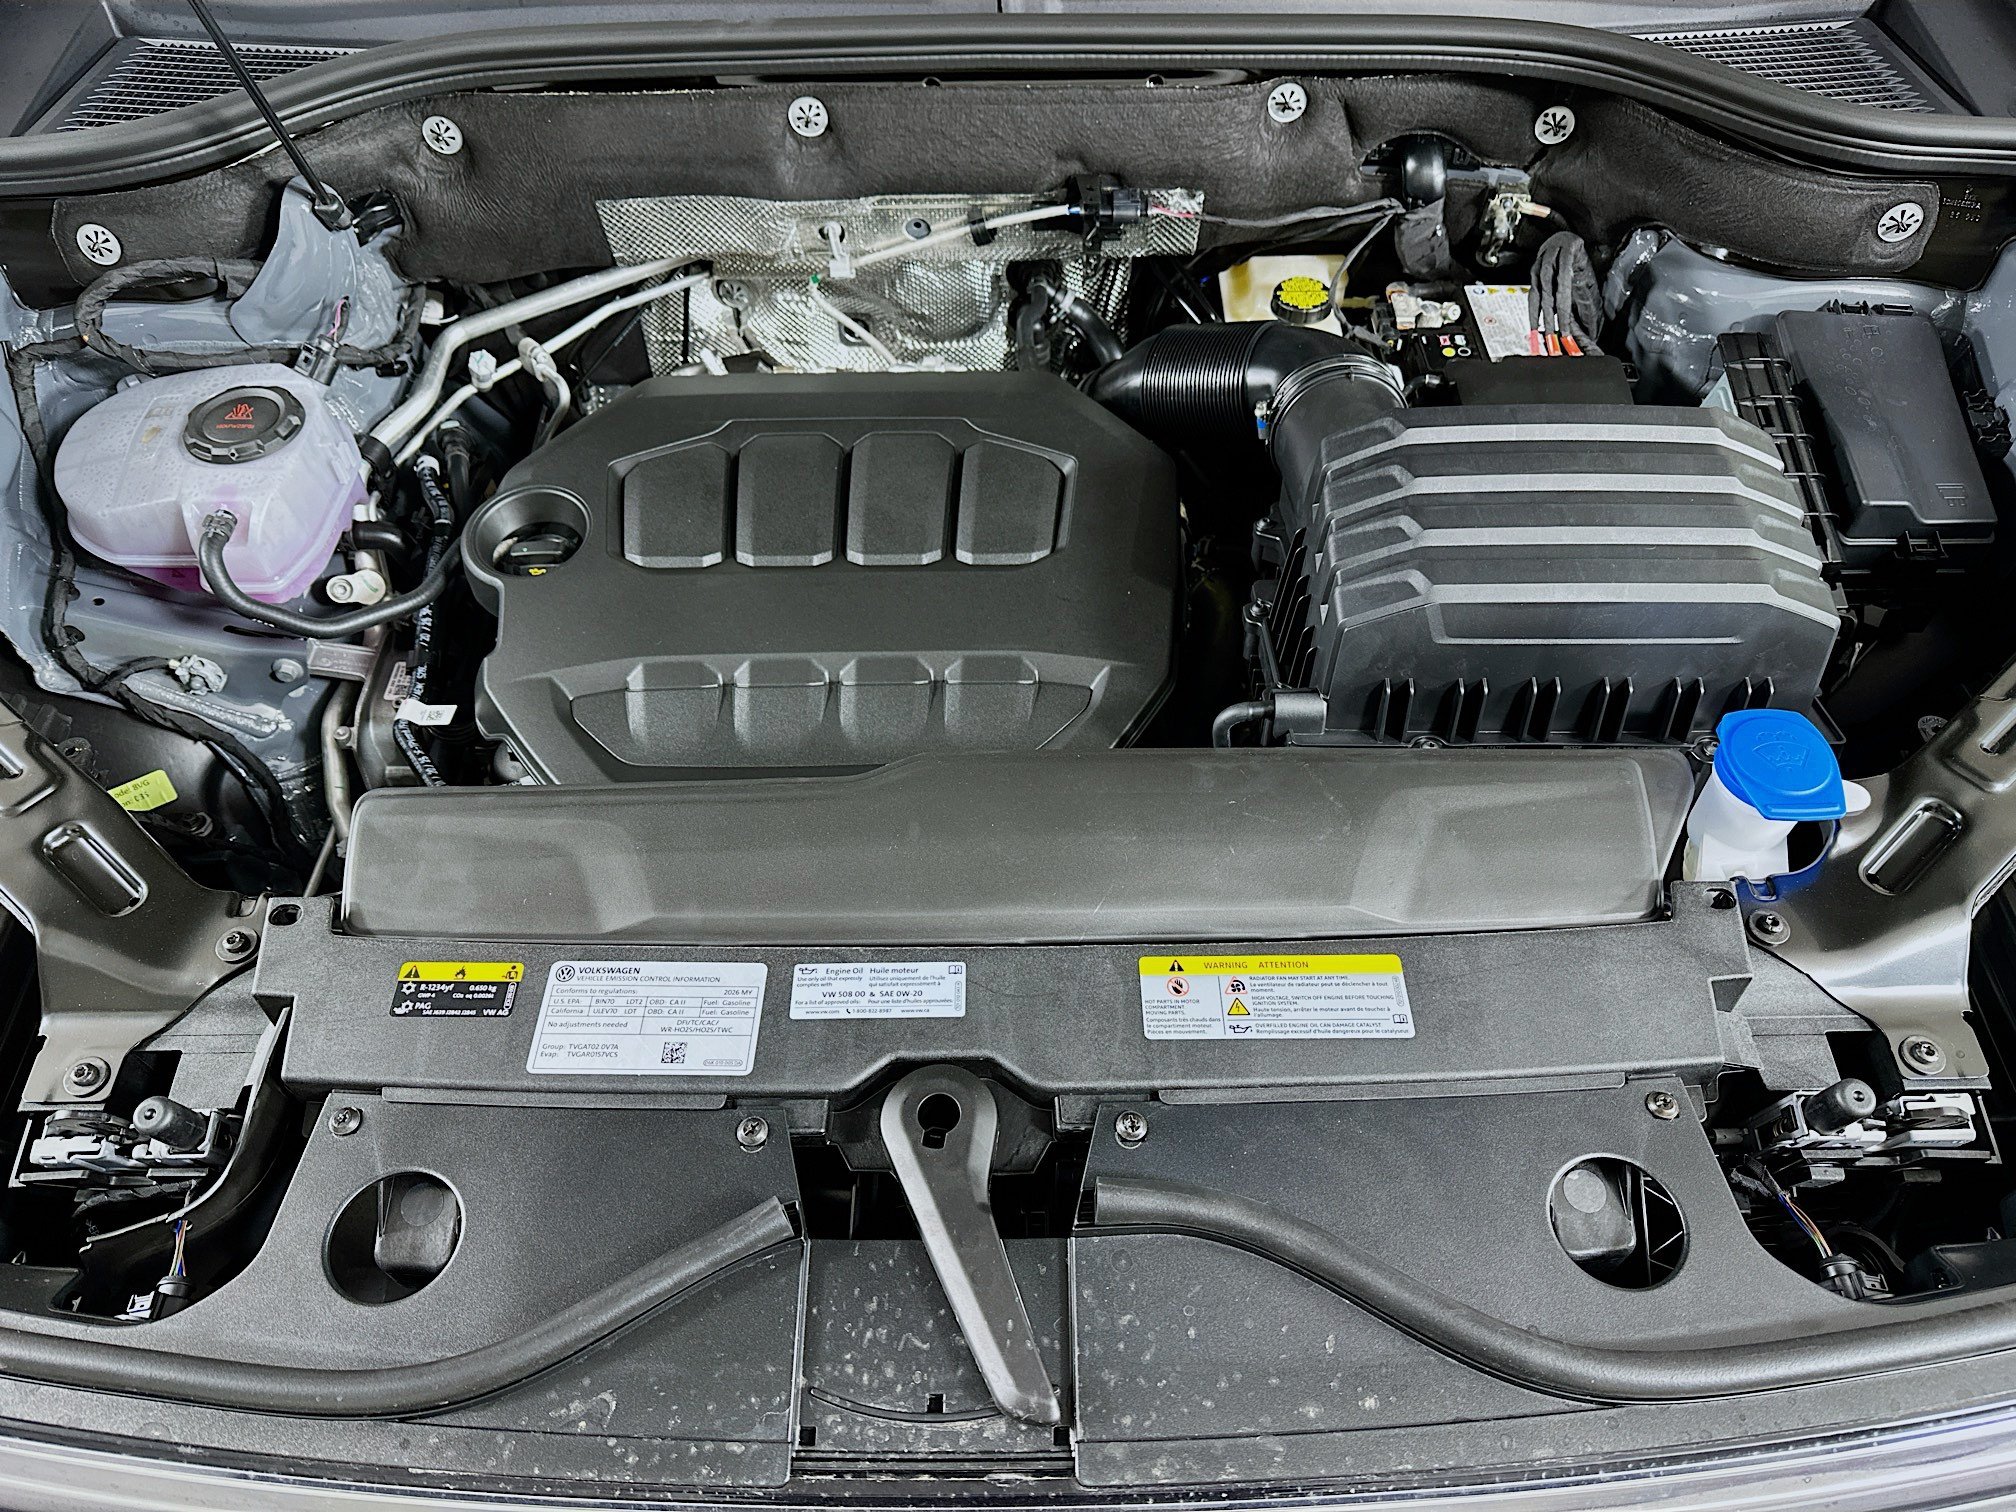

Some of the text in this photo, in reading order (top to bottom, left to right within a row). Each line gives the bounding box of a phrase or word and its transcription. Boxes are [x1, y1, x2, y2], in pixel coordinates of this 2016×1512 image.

[1204, 961, 1309, 969] WARNING ATTENTION
[826, 967, 851, 976] Engine
[420, 984, 455, 993] R-1234yf
[415, 1002, 432, 1010] PAG
